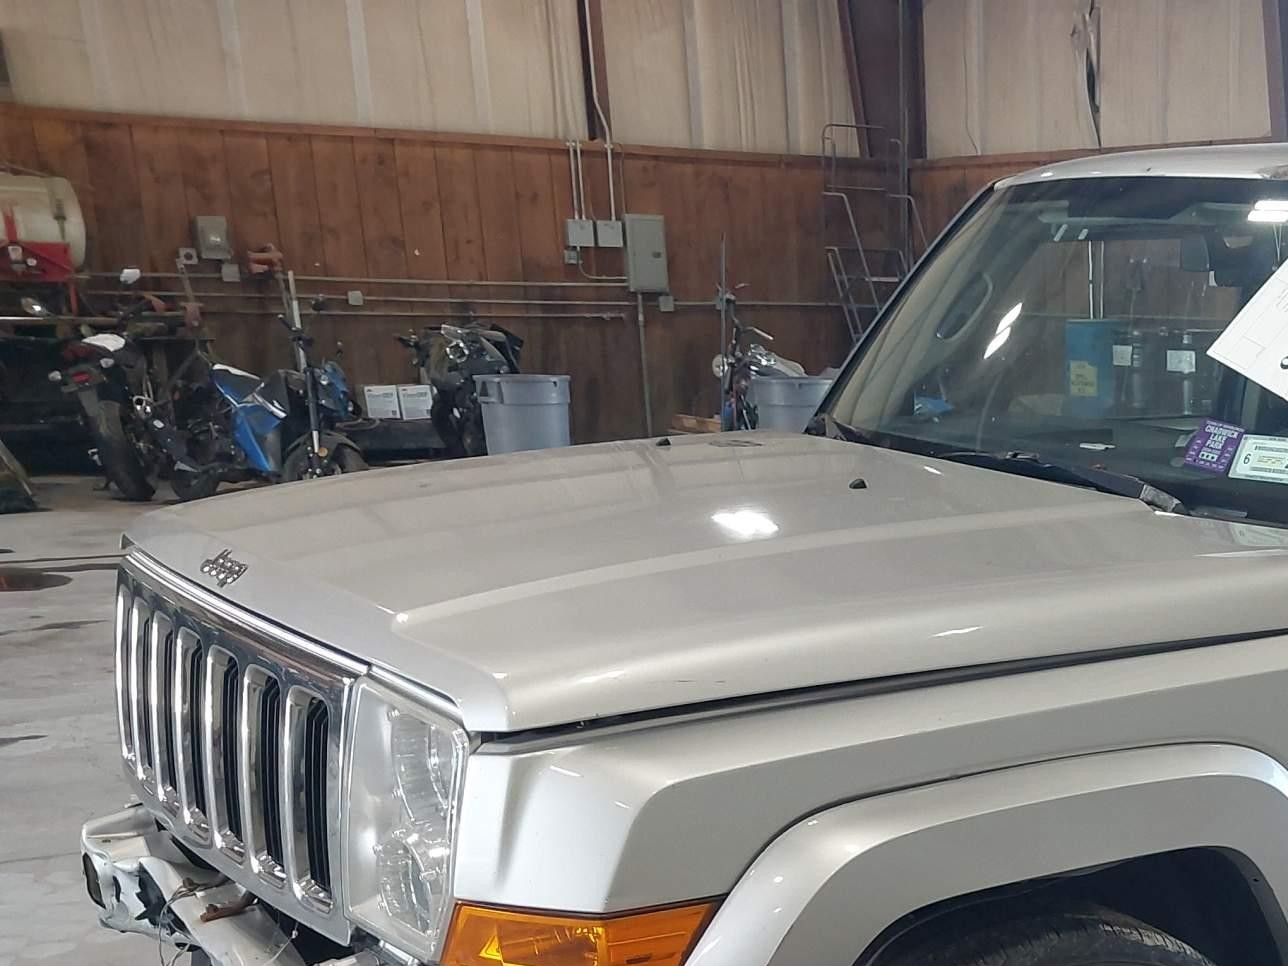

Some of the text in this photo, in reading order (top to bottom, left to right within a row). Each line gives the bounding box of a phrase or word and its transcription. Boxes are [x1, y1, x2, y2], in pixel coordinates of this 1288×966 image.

[1205, 424, 1239, 438] CHADWICK
[1210, 433, 1227, 443] LAKE
[1205, 439, 1225, 449] PARK
[1243, 453, 1252, 465] 6
